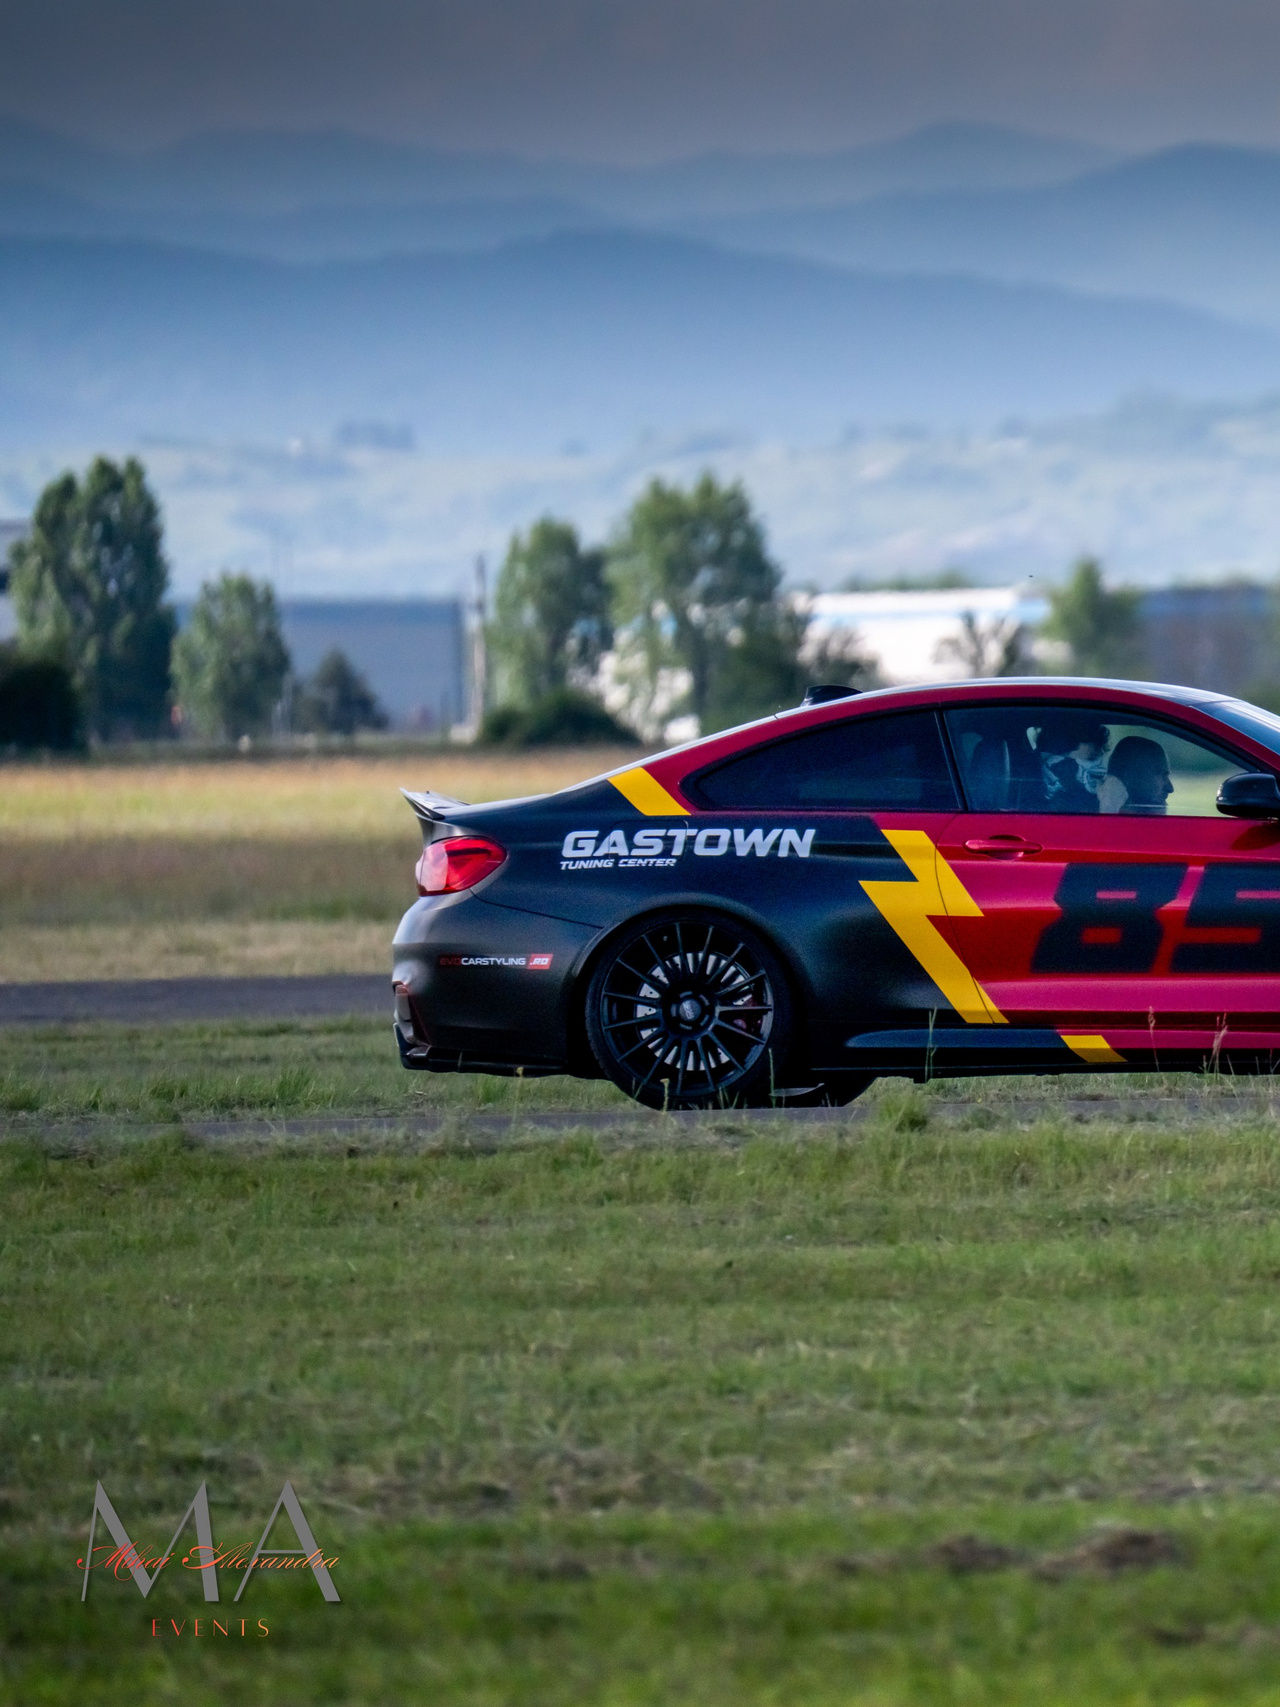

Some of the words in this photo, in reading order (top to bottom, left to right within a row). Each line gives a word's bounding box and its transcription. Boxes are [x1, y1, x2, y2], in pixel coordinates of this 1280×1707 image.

[561, 828, 816, 858] GASTOWN
[560, 858, 615, 870] TUNING
[618, 858, 677, 868] CENTER
